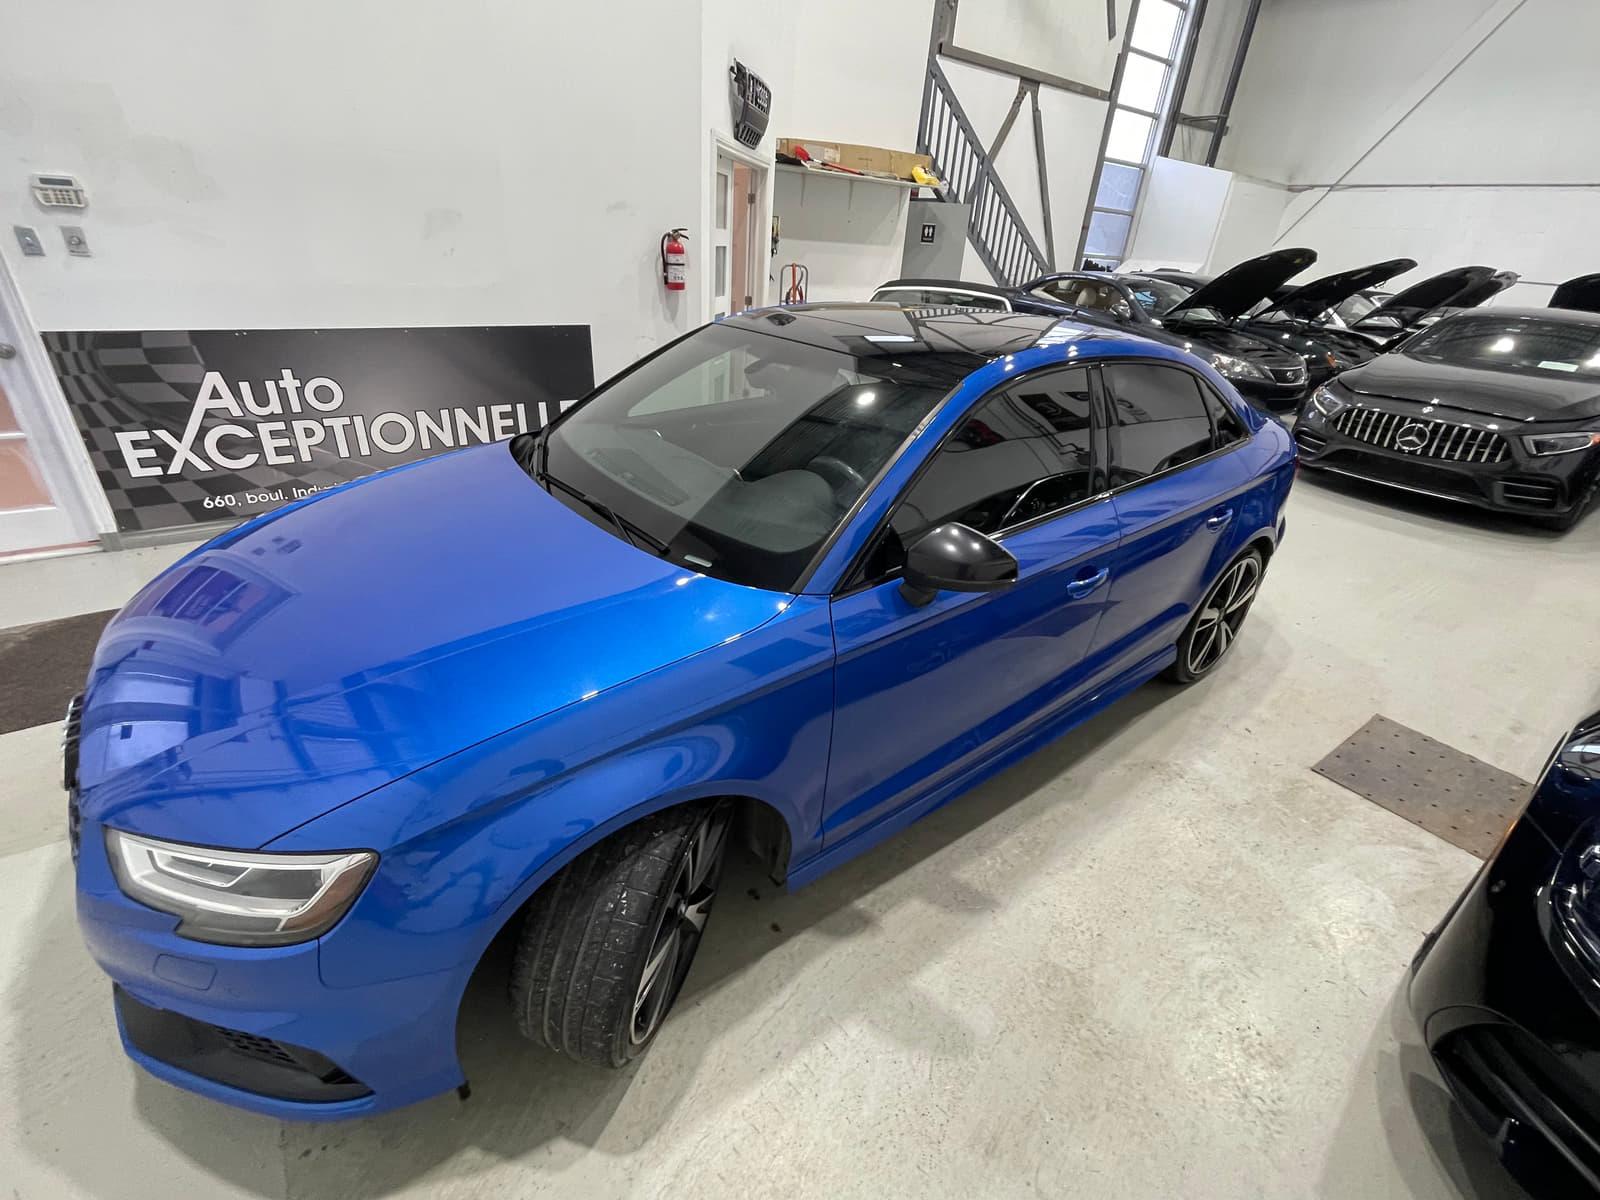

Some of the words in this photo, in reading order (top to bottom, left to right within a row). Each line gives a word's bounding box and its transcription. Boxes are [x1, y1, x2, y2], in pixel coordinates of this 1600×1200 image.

[191, 368, 344, 418] Auto
[203, 494, 242, 509] 660,
[245, 488, 289, 504] boul.
